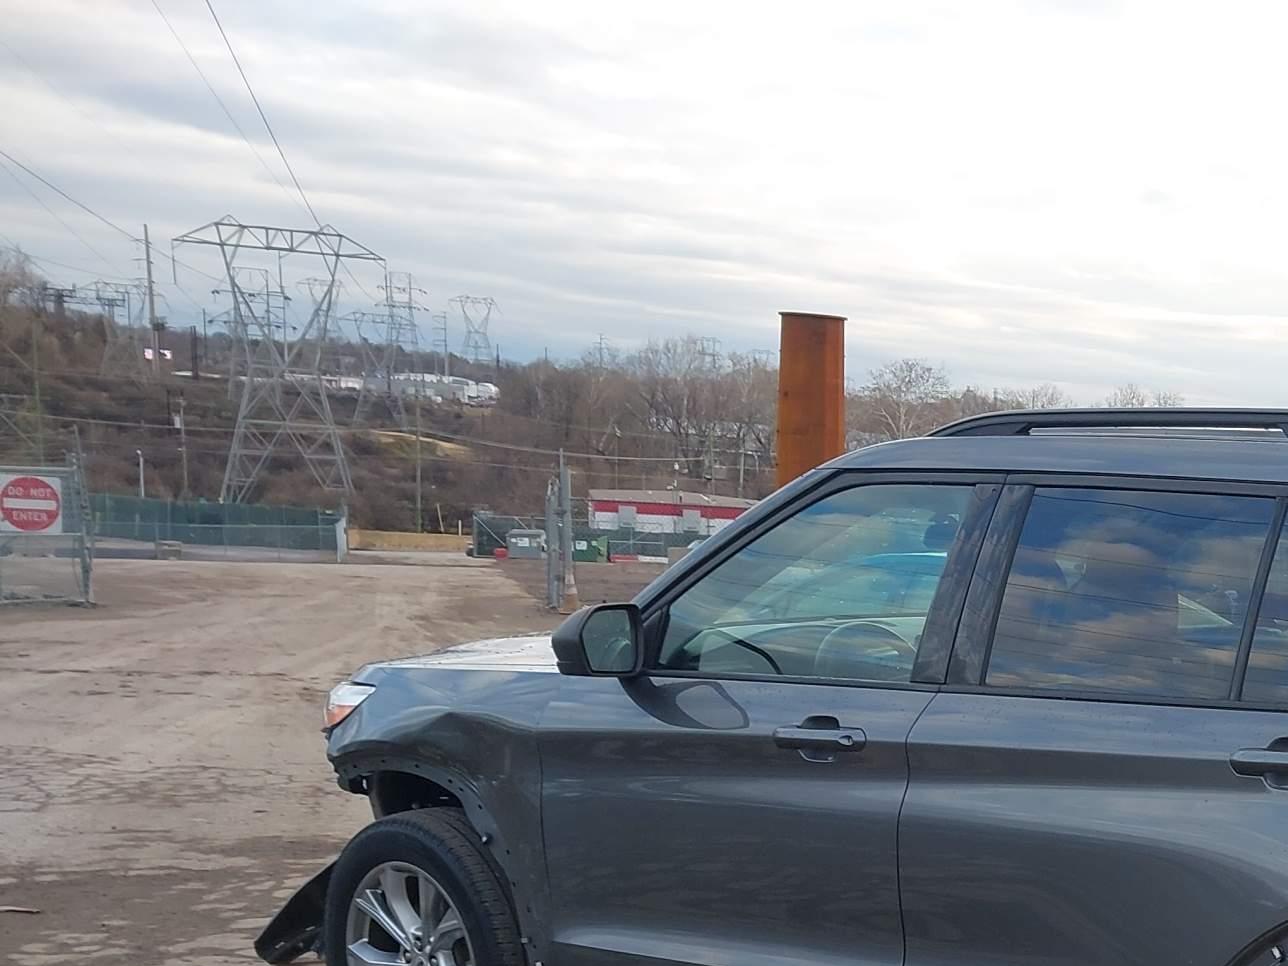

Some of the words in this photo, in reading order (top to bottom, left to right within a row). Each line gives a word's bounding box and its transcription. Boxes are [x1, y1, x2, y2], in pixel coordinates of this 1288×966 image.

[7, 486, 24, 496] DO
[31, 487, 52, 497] NOT
[12, 510, 48, 521] ENTER
